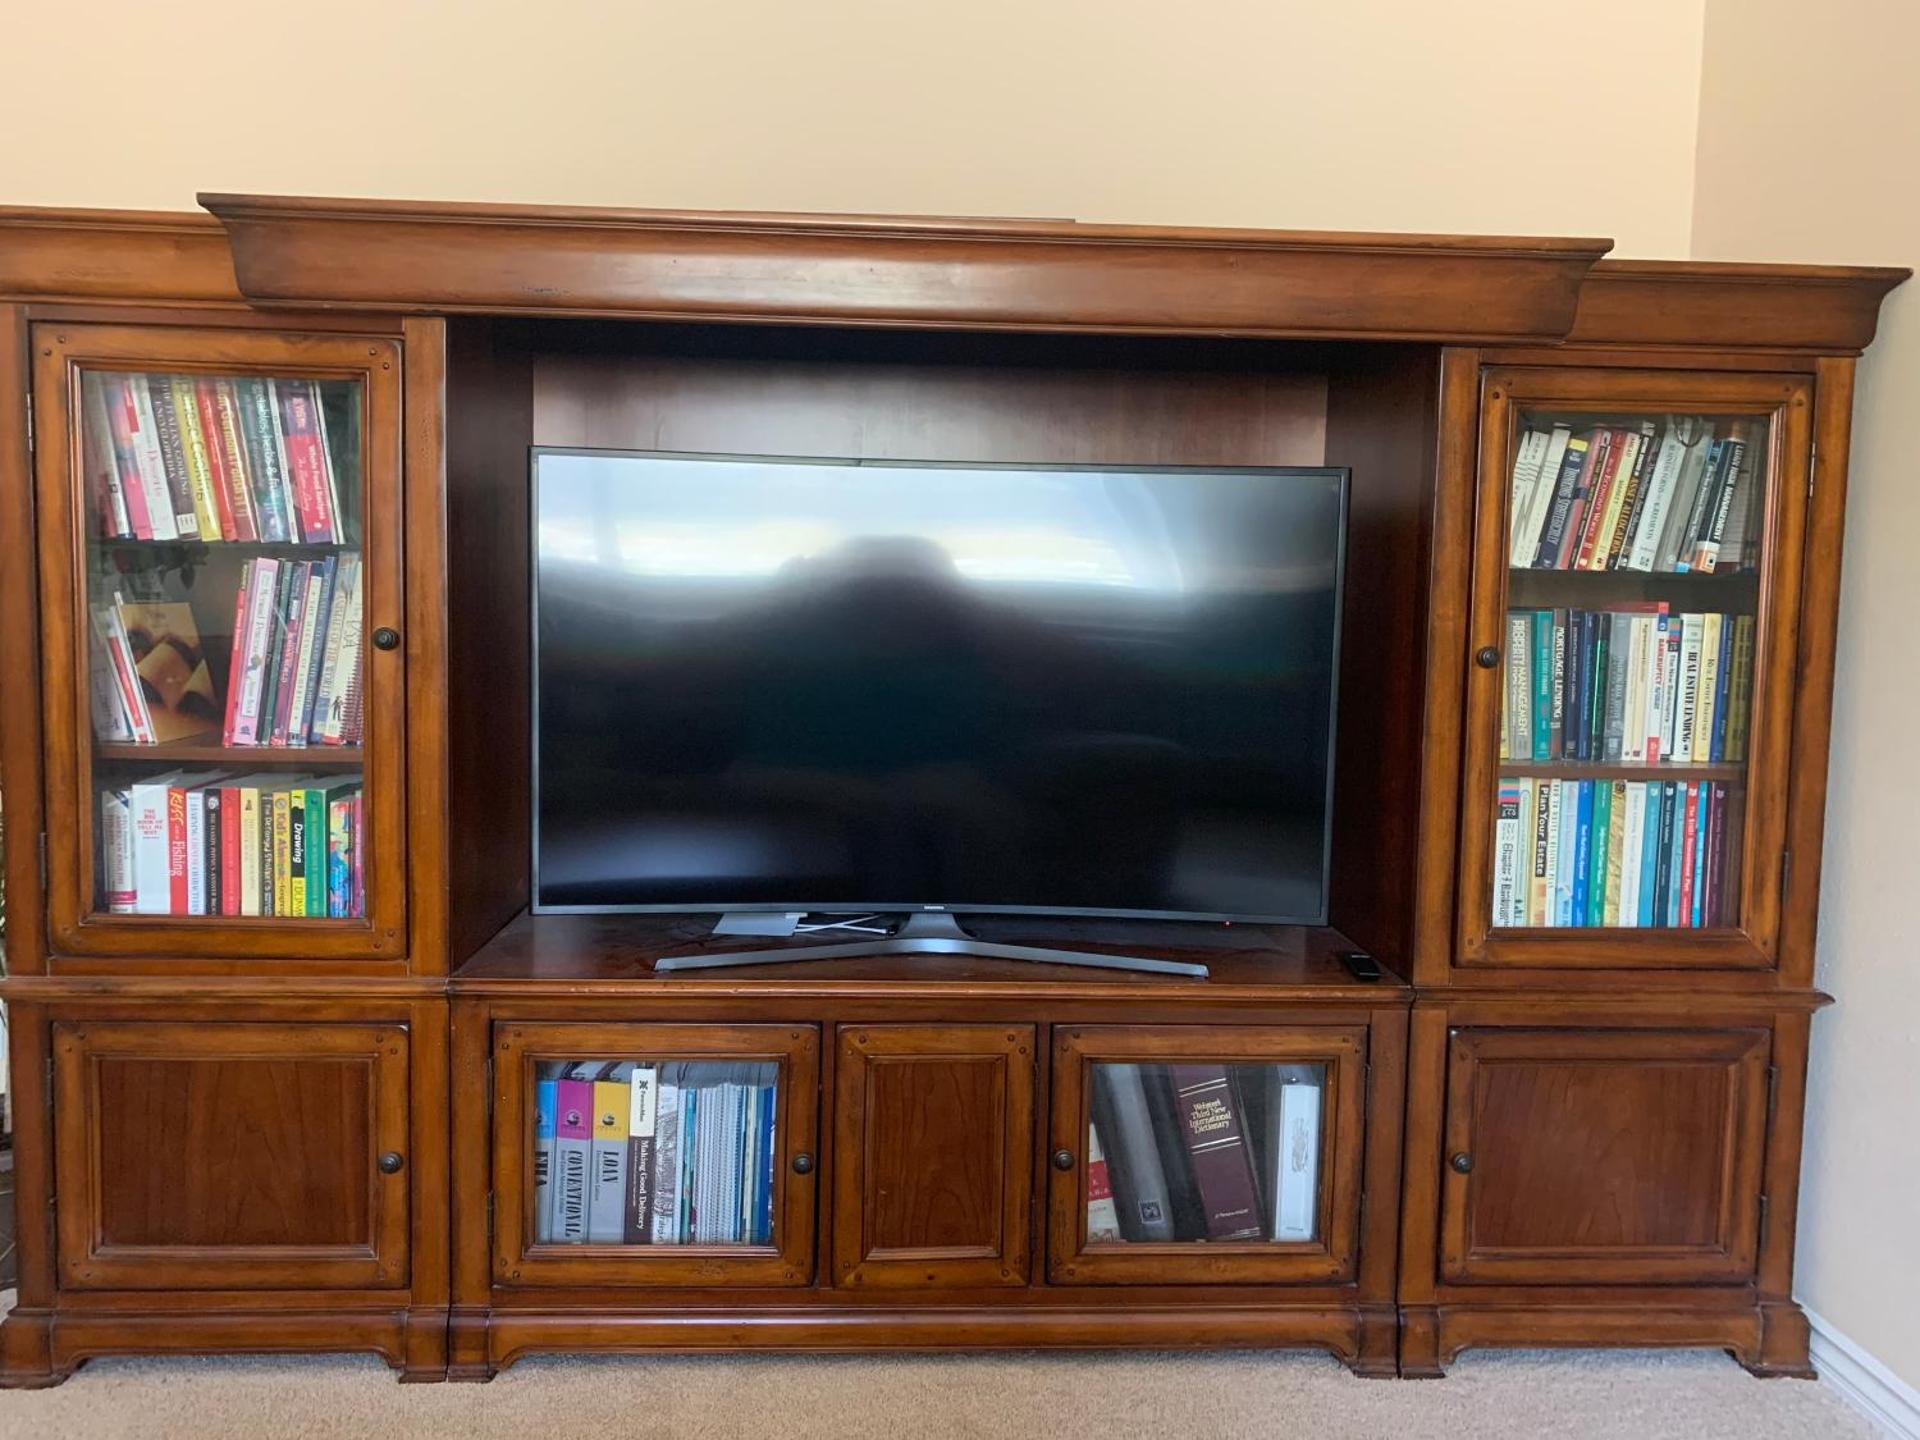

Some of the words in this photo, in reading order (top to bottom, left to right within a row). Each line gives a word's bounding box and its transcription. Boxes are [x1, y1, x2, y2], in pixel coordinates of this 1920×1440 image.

[1624, 479, 1640, 503] ASSET
[1609, 505, 1634, 555] ALLOCATION
[1712, 486, 1734, 541] MANAGEMENT
[1553, 626, 1565, 676] MORTGAGE
[1654, 638, 1666, 685] BANKRUPTCY
[1685, 651, 1698, 672] REAL
[1516, 666, 1528, 737] MANAGEMENT
[1552, 678, 1563, 718] LENDING
[1683, 675, 1696, 704] ESTATE
[1680, 707, 1694, 742] LENDING
[1538, 786, 1550, 810] Plan
[1537, 812, 1548, 838] Your
[170, 841, 186, 878] Fishing
[291, 823, 305, 864] Drawing
[1535, 841, 1546, 875] Estate
[600, 1150, 620, 1183] LOAN
[637, 1139, 649, 1172] Making
[562, 1149, 585, 1237] CONVENTIONAL
[638, 1172, 648, 1194] Good
[636, 1196, 647, 1230] Delivery
